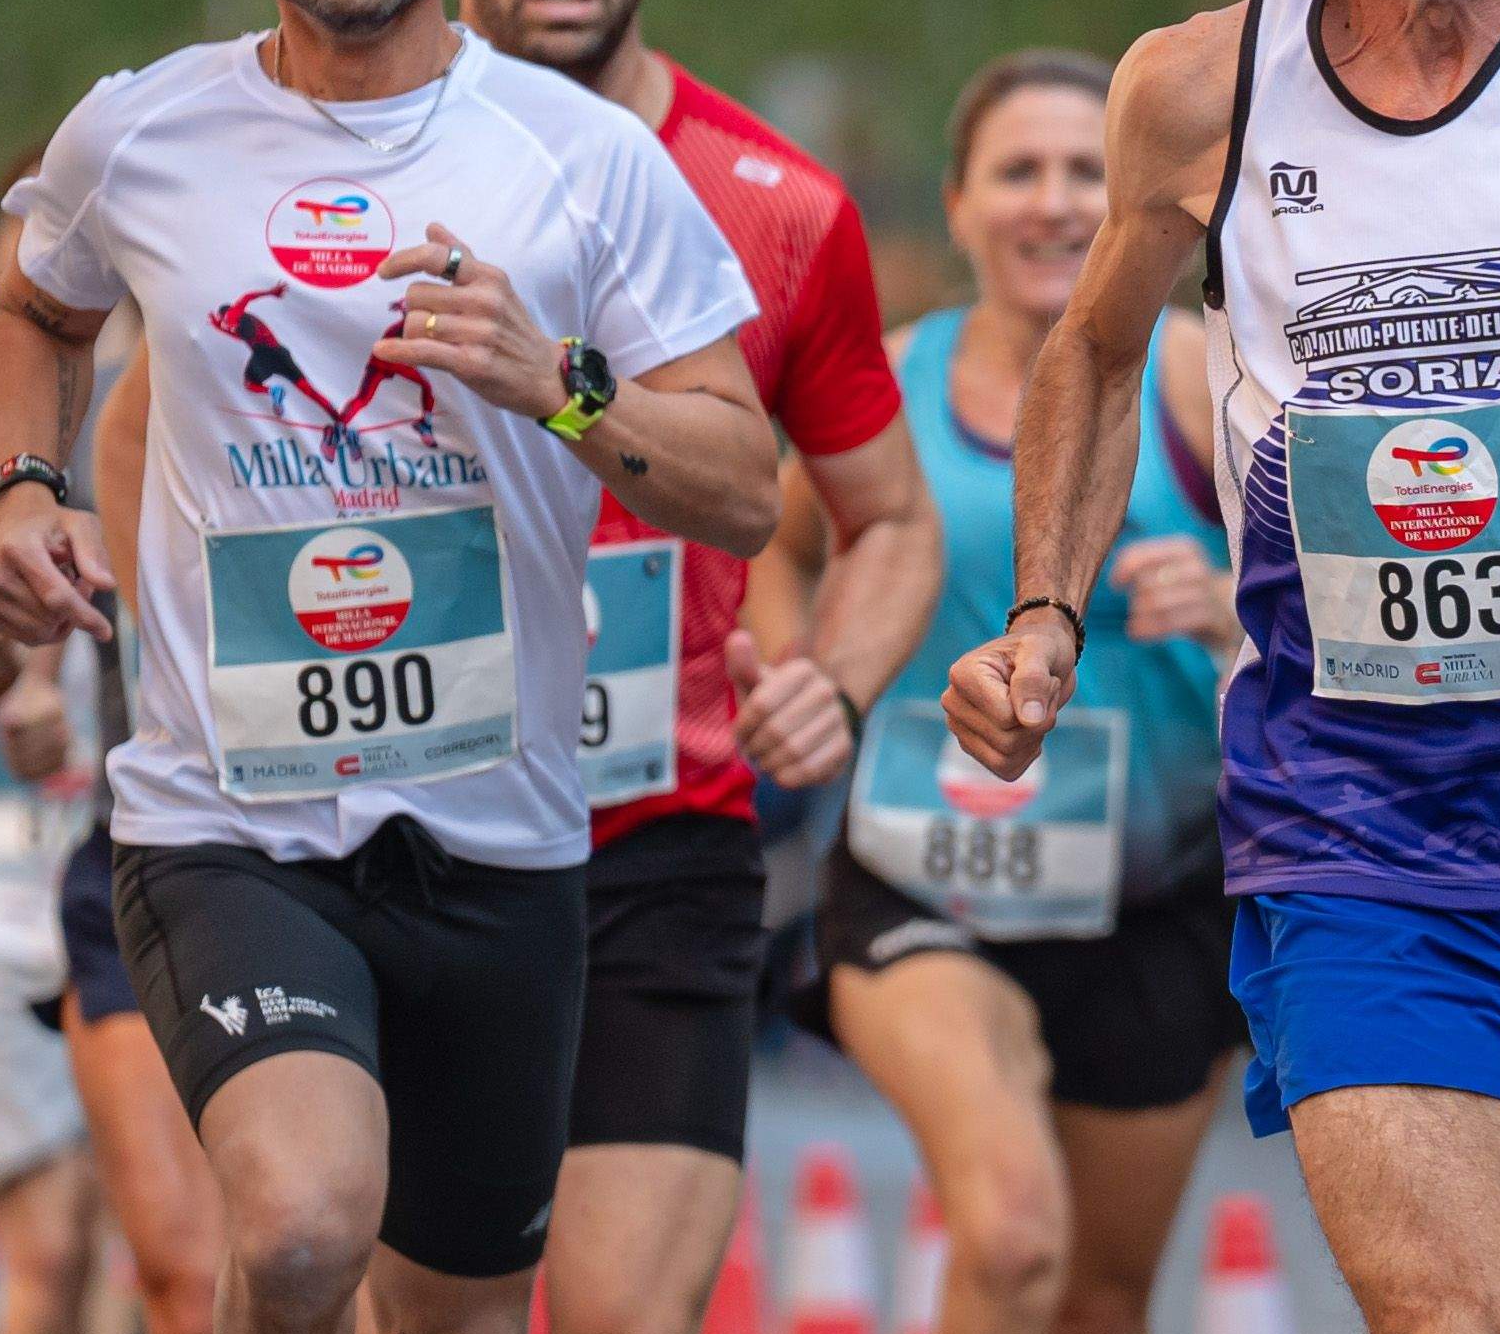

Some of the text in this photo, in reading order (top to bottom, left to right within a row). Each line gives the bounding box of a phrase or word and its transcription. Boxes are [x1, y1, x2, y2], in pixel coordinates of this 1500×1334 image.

[295, 231, 368, 243] TotalEnergies
[310, 250, 354, 262] MILLA
[315, 263, 370, 275] MADRID
[1381, 316, 1460, 346] PUENTE
[226, 438, 488, 489] Milla Urbana
[1394, 482, 1474, 496] TotalEnergies
[334, 487, 400, 510] Madrid
[1416, 505, 1455, 517] MILLA
[1404, 527, 1471, 542] DE MADRID
[315, 585, 390, 601] TotalEnergies
[1341, 661, 1400, 679] MADRID
[1443, 659, 1486, 671] MILLA
[1444, 670, 1495, 683] URBANA
[298, 653, 435, 738] 890
[252, 762, 316, 780] MADRID
